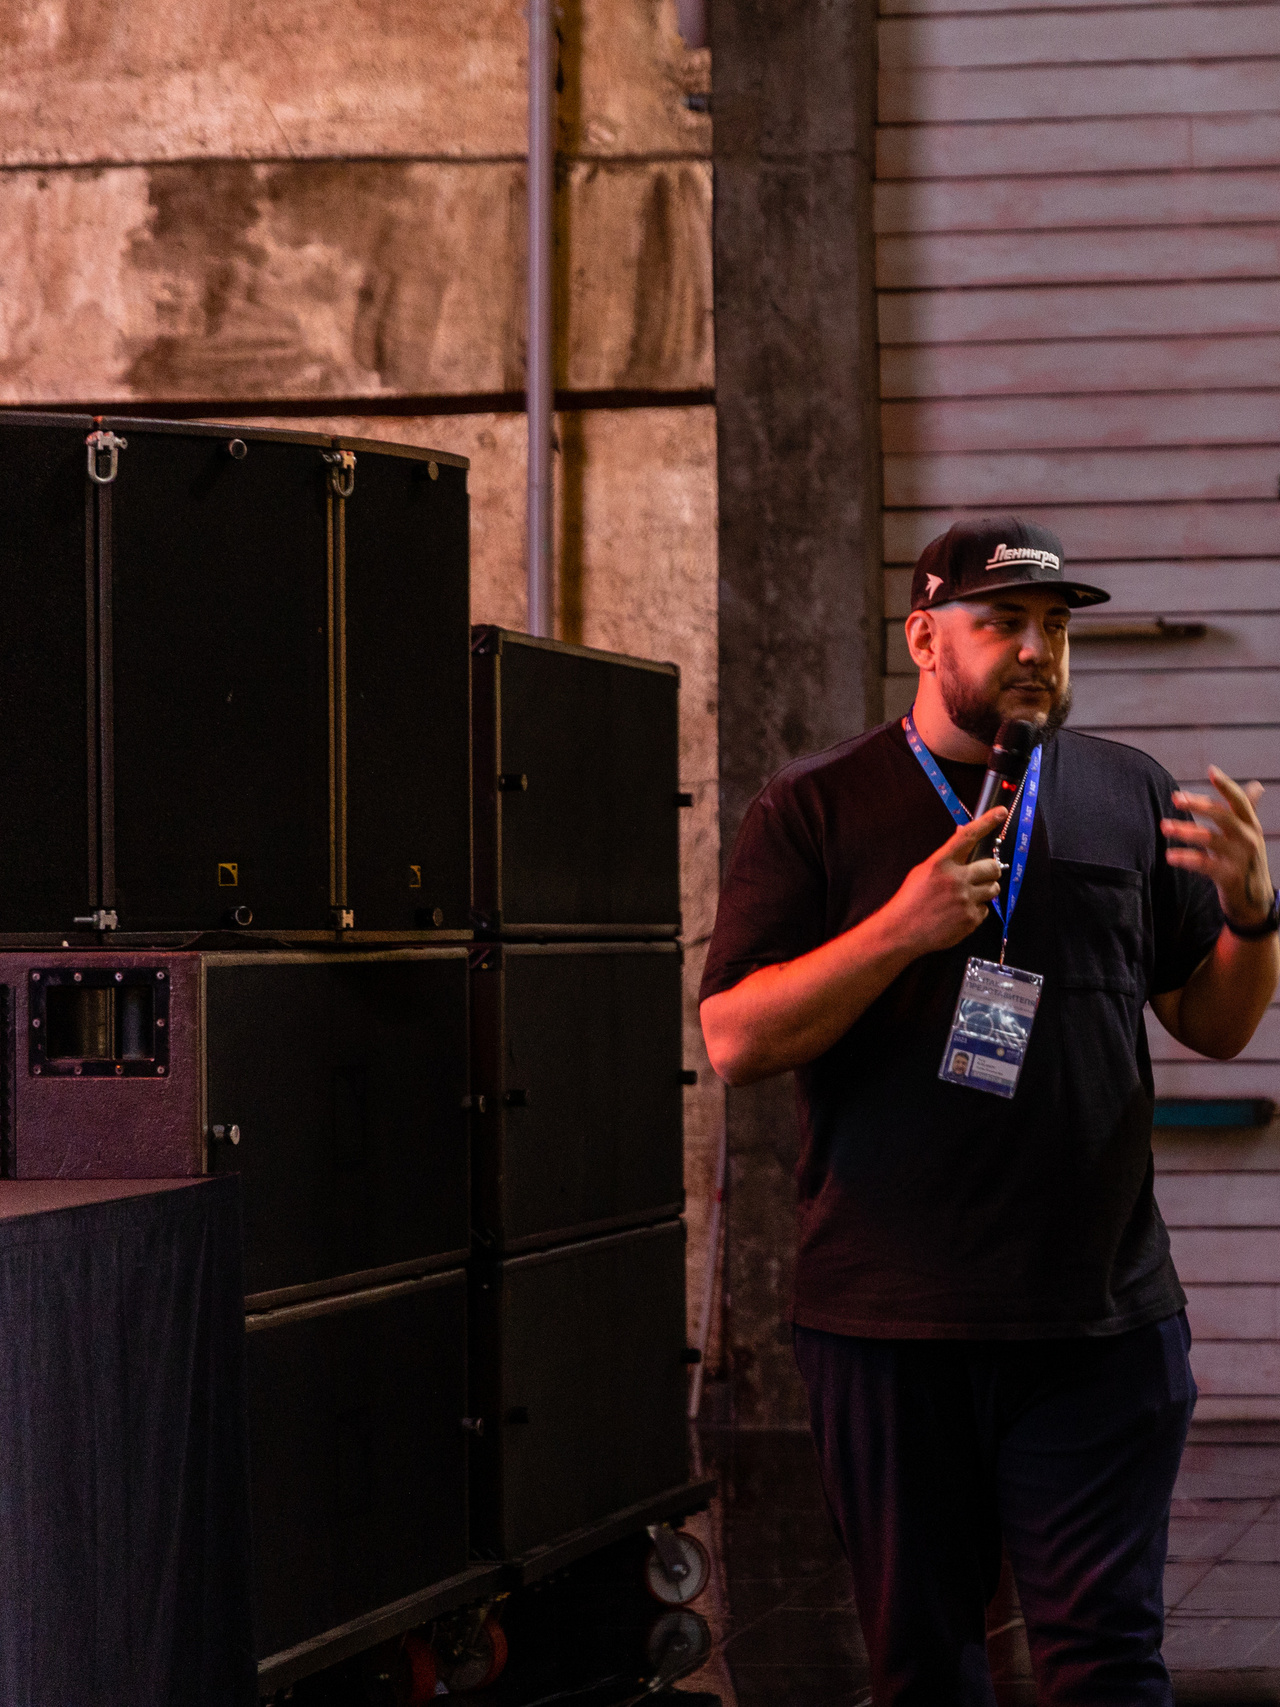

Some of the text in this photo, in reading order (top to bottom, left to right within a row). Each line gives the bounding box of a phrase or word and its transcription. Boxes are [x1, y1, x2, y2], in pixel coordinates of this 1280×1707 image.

[1029, 780, 1037, 792] AST
[1020, 833, 1029, 846] AST
[1016, 863, 1024, 877] AST
